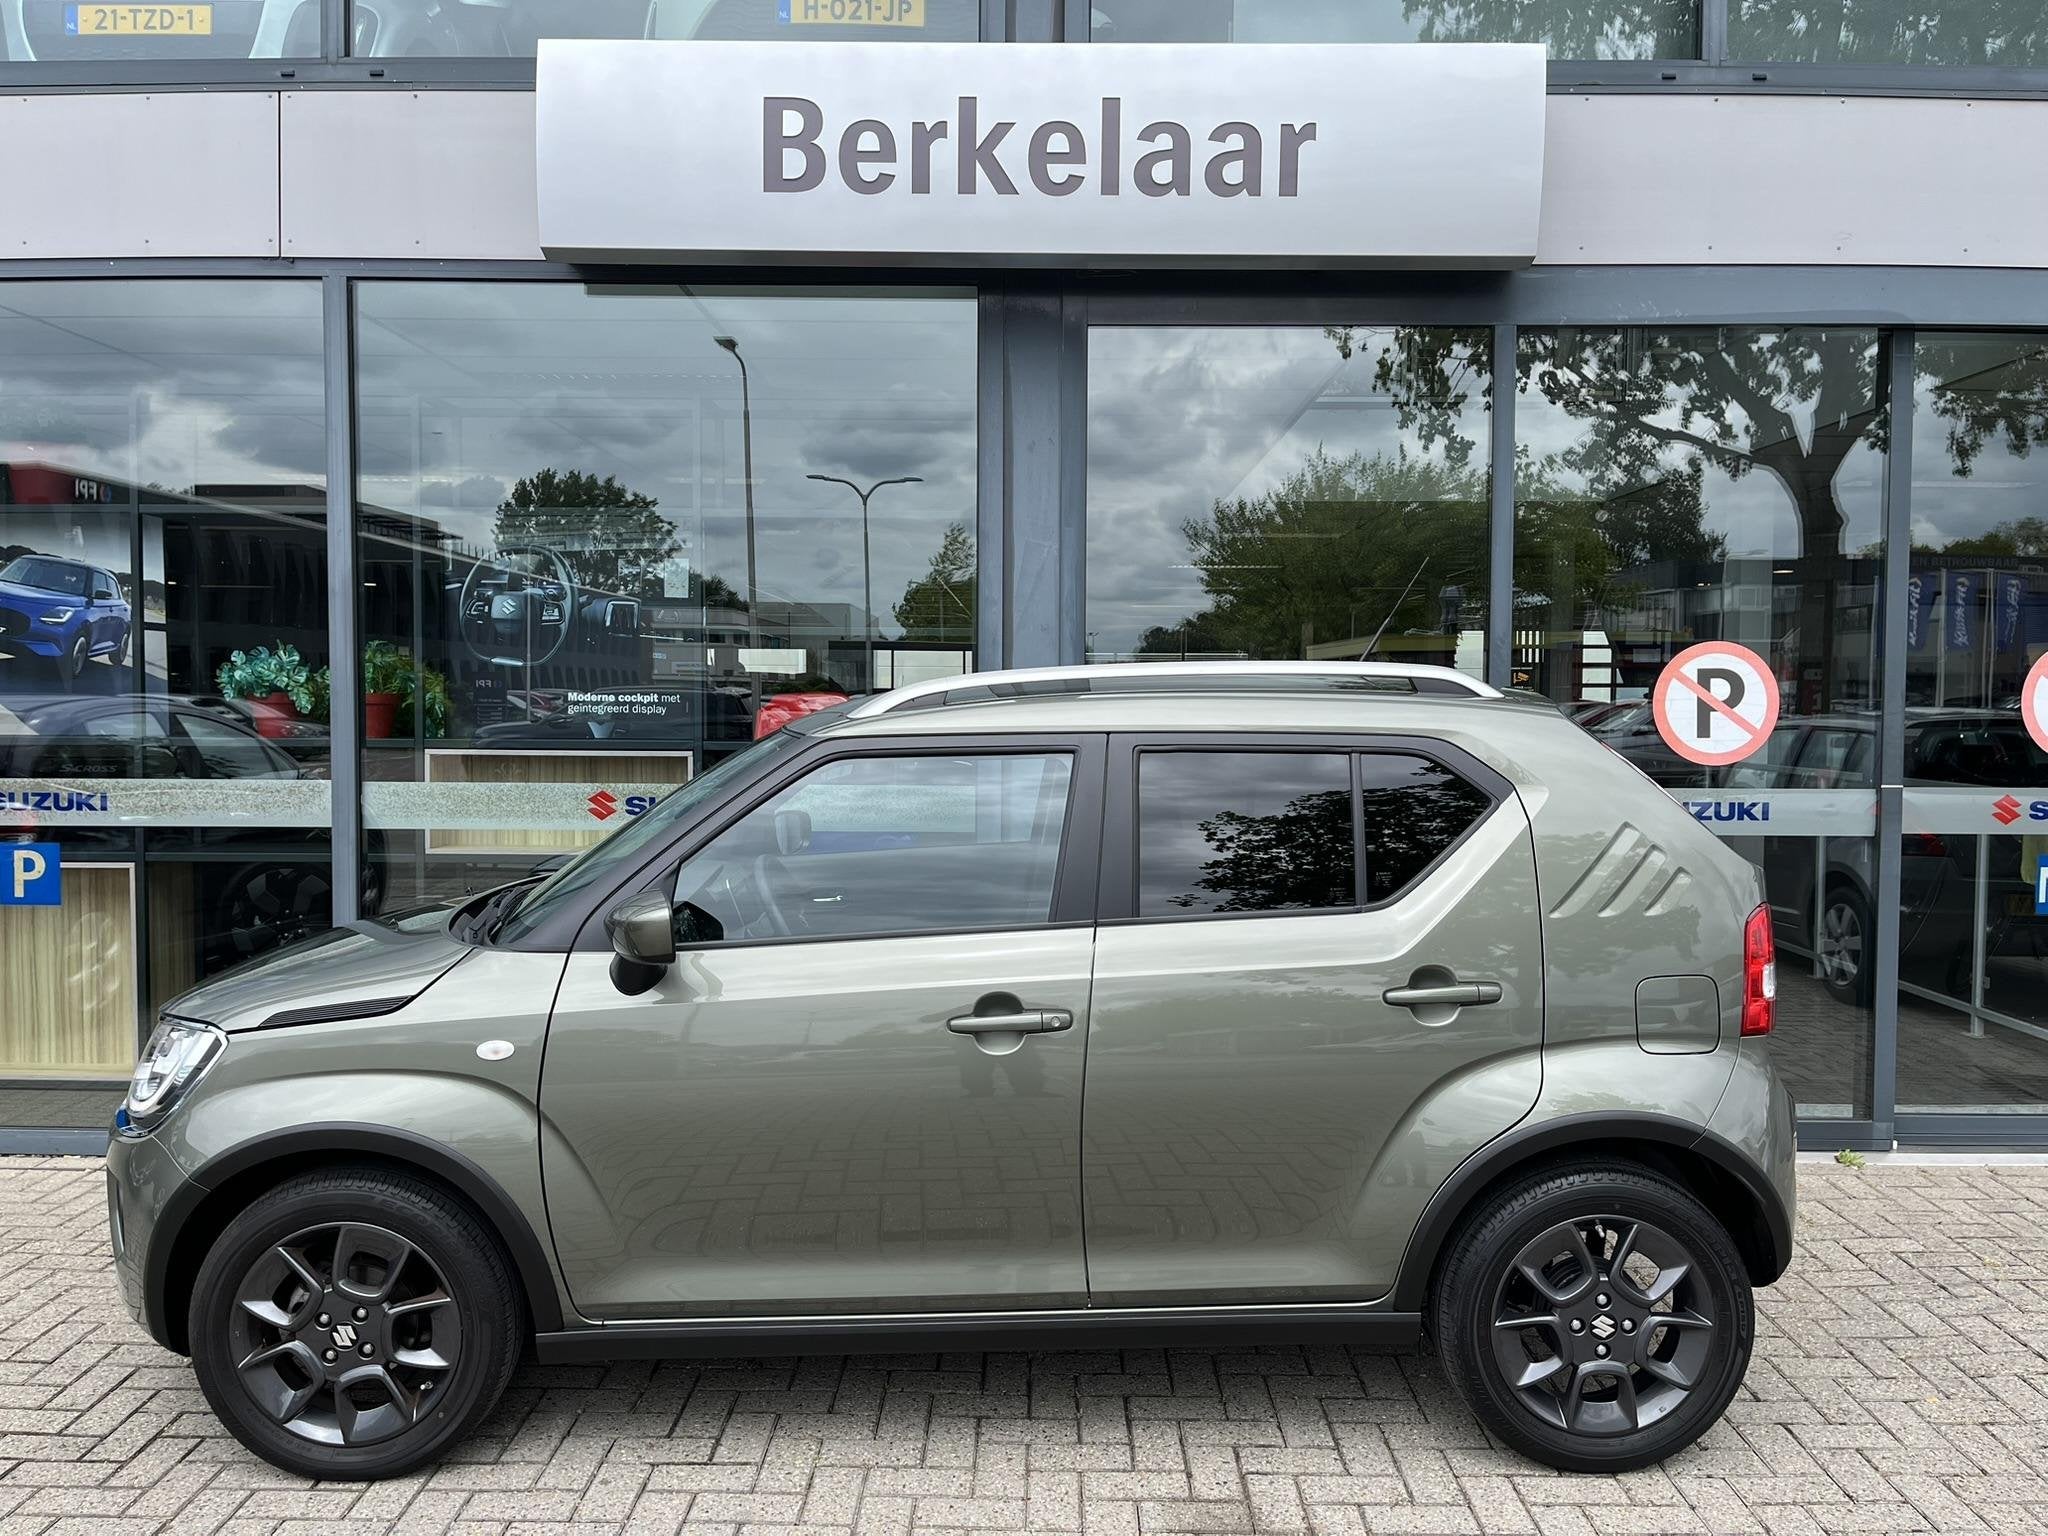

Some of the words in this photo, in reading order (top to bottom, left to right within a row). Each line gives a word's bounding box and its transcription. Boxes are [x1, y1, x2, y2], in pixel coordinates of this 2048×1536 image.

[94, 8, 194, 31] 21-TZD-1
[803, 0, 912, 21] H-021-JP
[762, 96, 1318, 198] Berkelaar
[568, 692, 615, 702] Moderne
[618, 693, 659, 704] cockpit
[661, 694, 681, 703] met
[1697, 668, 1745, 739] P
[632, 704, 667, 716] display
[1682, 802, 1770, 822] ZUKI
[14, 849, 46, 898] P
